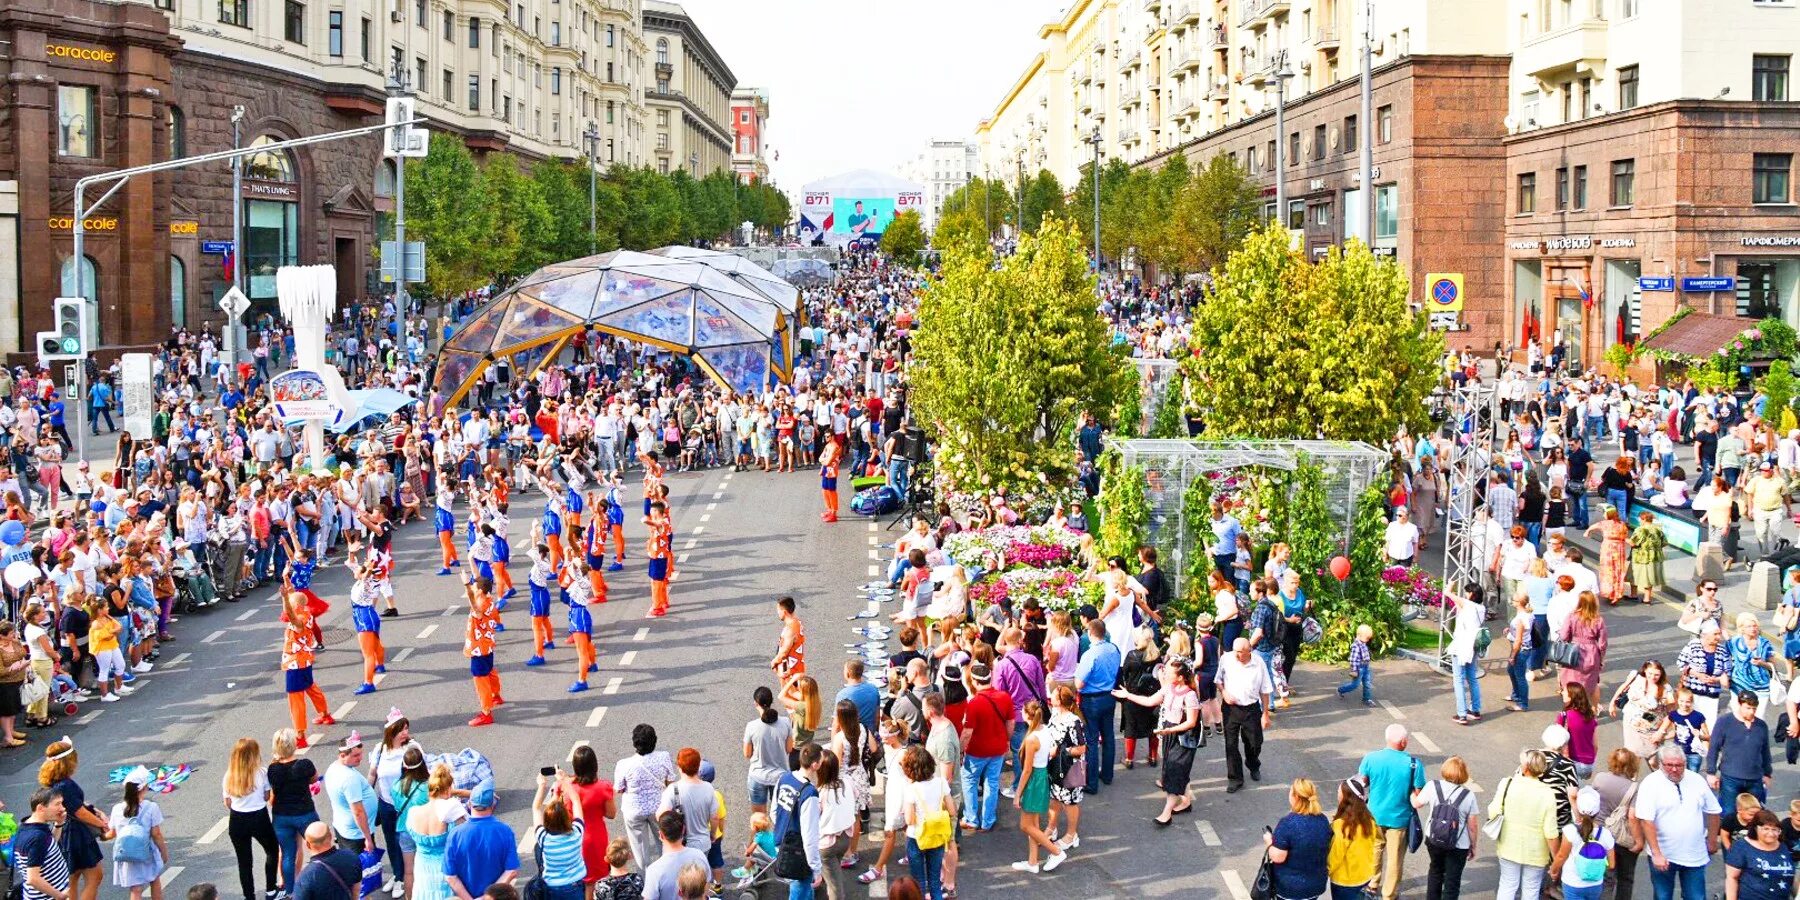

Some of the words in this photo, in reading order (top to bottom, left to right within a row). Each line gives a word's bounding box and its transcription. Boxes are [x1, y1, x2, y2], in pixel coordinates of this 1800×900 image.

[46, 44, 114, 63] caracole
[805, 196, 829, 205] 871
[898, 196, 922, 205] 871
[49, 218, 116, 230] carcole
